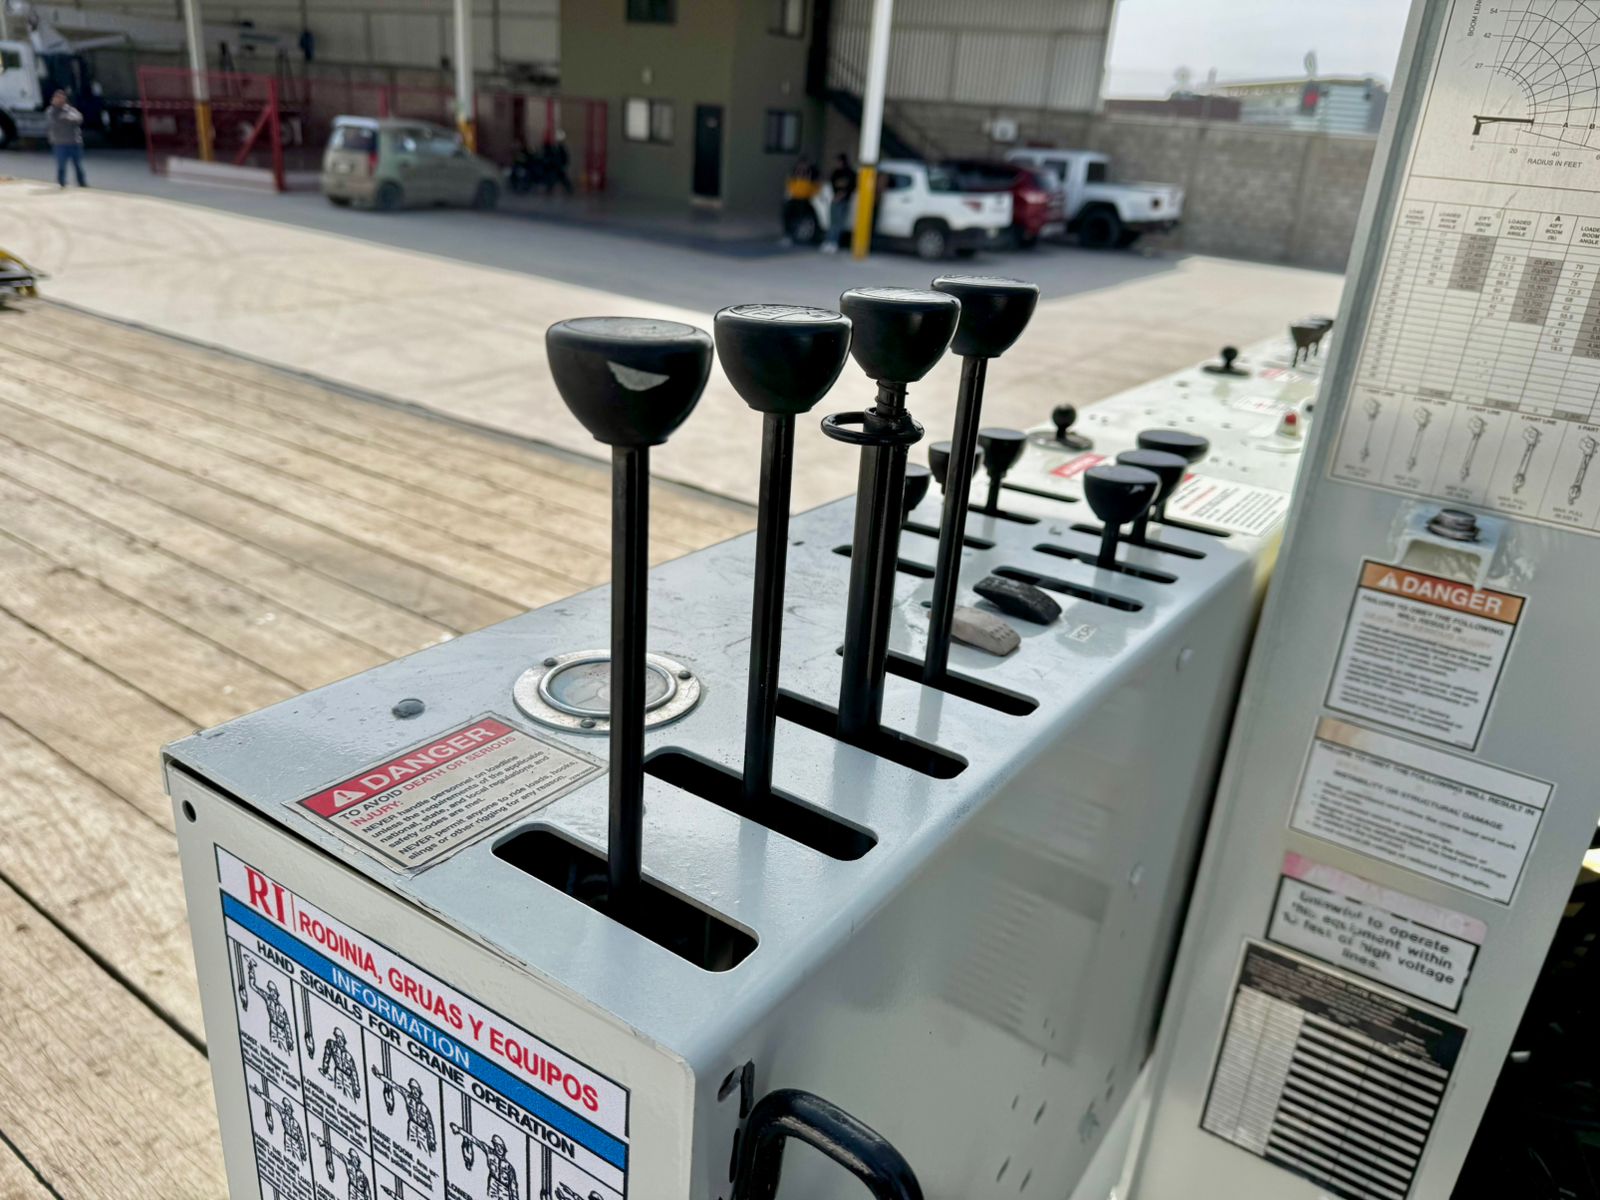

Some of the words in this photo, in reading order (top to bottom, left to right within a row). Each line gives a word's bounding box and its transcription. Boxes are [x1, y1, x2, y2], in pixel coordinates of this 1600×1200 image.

[1527, 158, 1554, 166] RADIUS
[1402, 576, 1502, 614] DANGER
[338, 809, 360, 819] TO
[363, 789, 402, 810] AVOID
[402, 769, 445, 790] DEATH
[445, 759, 466, 770] OR
[465, 736, 515, 761] SERIOUS
[361, 727, 494, 789] DANGER
[350, 800, 403, 826] INJURY:
[361, 814, 397, 832] NEVER
[396, 799, 429, 815] handle
[430, 776, 473, 800] personnel
[484, 755, 518, 772] loadline
[371, 821, 403, 837] unless
[402, 812, 420, 821] the
[420, 783, 478, 813] requirements
[487, 771, 503, 779] the
[504, 751, 543, 771] applicable
[379, 821, 422, 842] national,
[421, 808, 449, 821] state,
[448, 797, 466, 808] and
[465, 785, 489, 798] local
[488, 764, 533, 787] regulations
[533, 755, 549, 765] and
[388, 831, 418, 847] safety
[419, 816, 448, 832] codes
[448, 808, 464, 817] are
[464, 798, 485, 809] met.
[398, 834, 434, 854] NEVER
[434, 818, 465, 836] permit
[465, 801, 498, 819] anyone
[508, 787, 526, 797] ride
[524, 775, 552, 788] loads,
[549, 761, 578, 775] hooks,
[408, 843, 437, 859] slings
[450, 822, 474, 837] other
[475, 806, 507, 823] rigging
[505, 798, 519, 806] for
[520, 790, 536, 799] any
[536, 775, 566, 791] reason.
[1462, 812, 1502, 829] DAMAGE
[1488, 796, 1522, 811] RESULT
[245, 866, 284, 923] RI
[1367, 916, 1383, 928] to
[1389, 926, 1449, 953] operate
[1407, 947, 1451, 968] within
[1398, 958, 1454, 983] voltage
[299, 911, 381, 983] RODINIA,
[388, 967, 462, 1028] GRUAS
[468, 1014, 483, 1040] Y
[490, 1028, 597, 1110] EQUIPOS
[332, 968, 468, 1067] INFORMATION
[256, 940, 294, 974] HAND
[300, 970, 362, 1020] SIGNALS
[368, 1013, 400, 1045] FOR
[407, 1041, 464, 1087] CRANE
[471, 1082, 574, 1157] OPERATION
